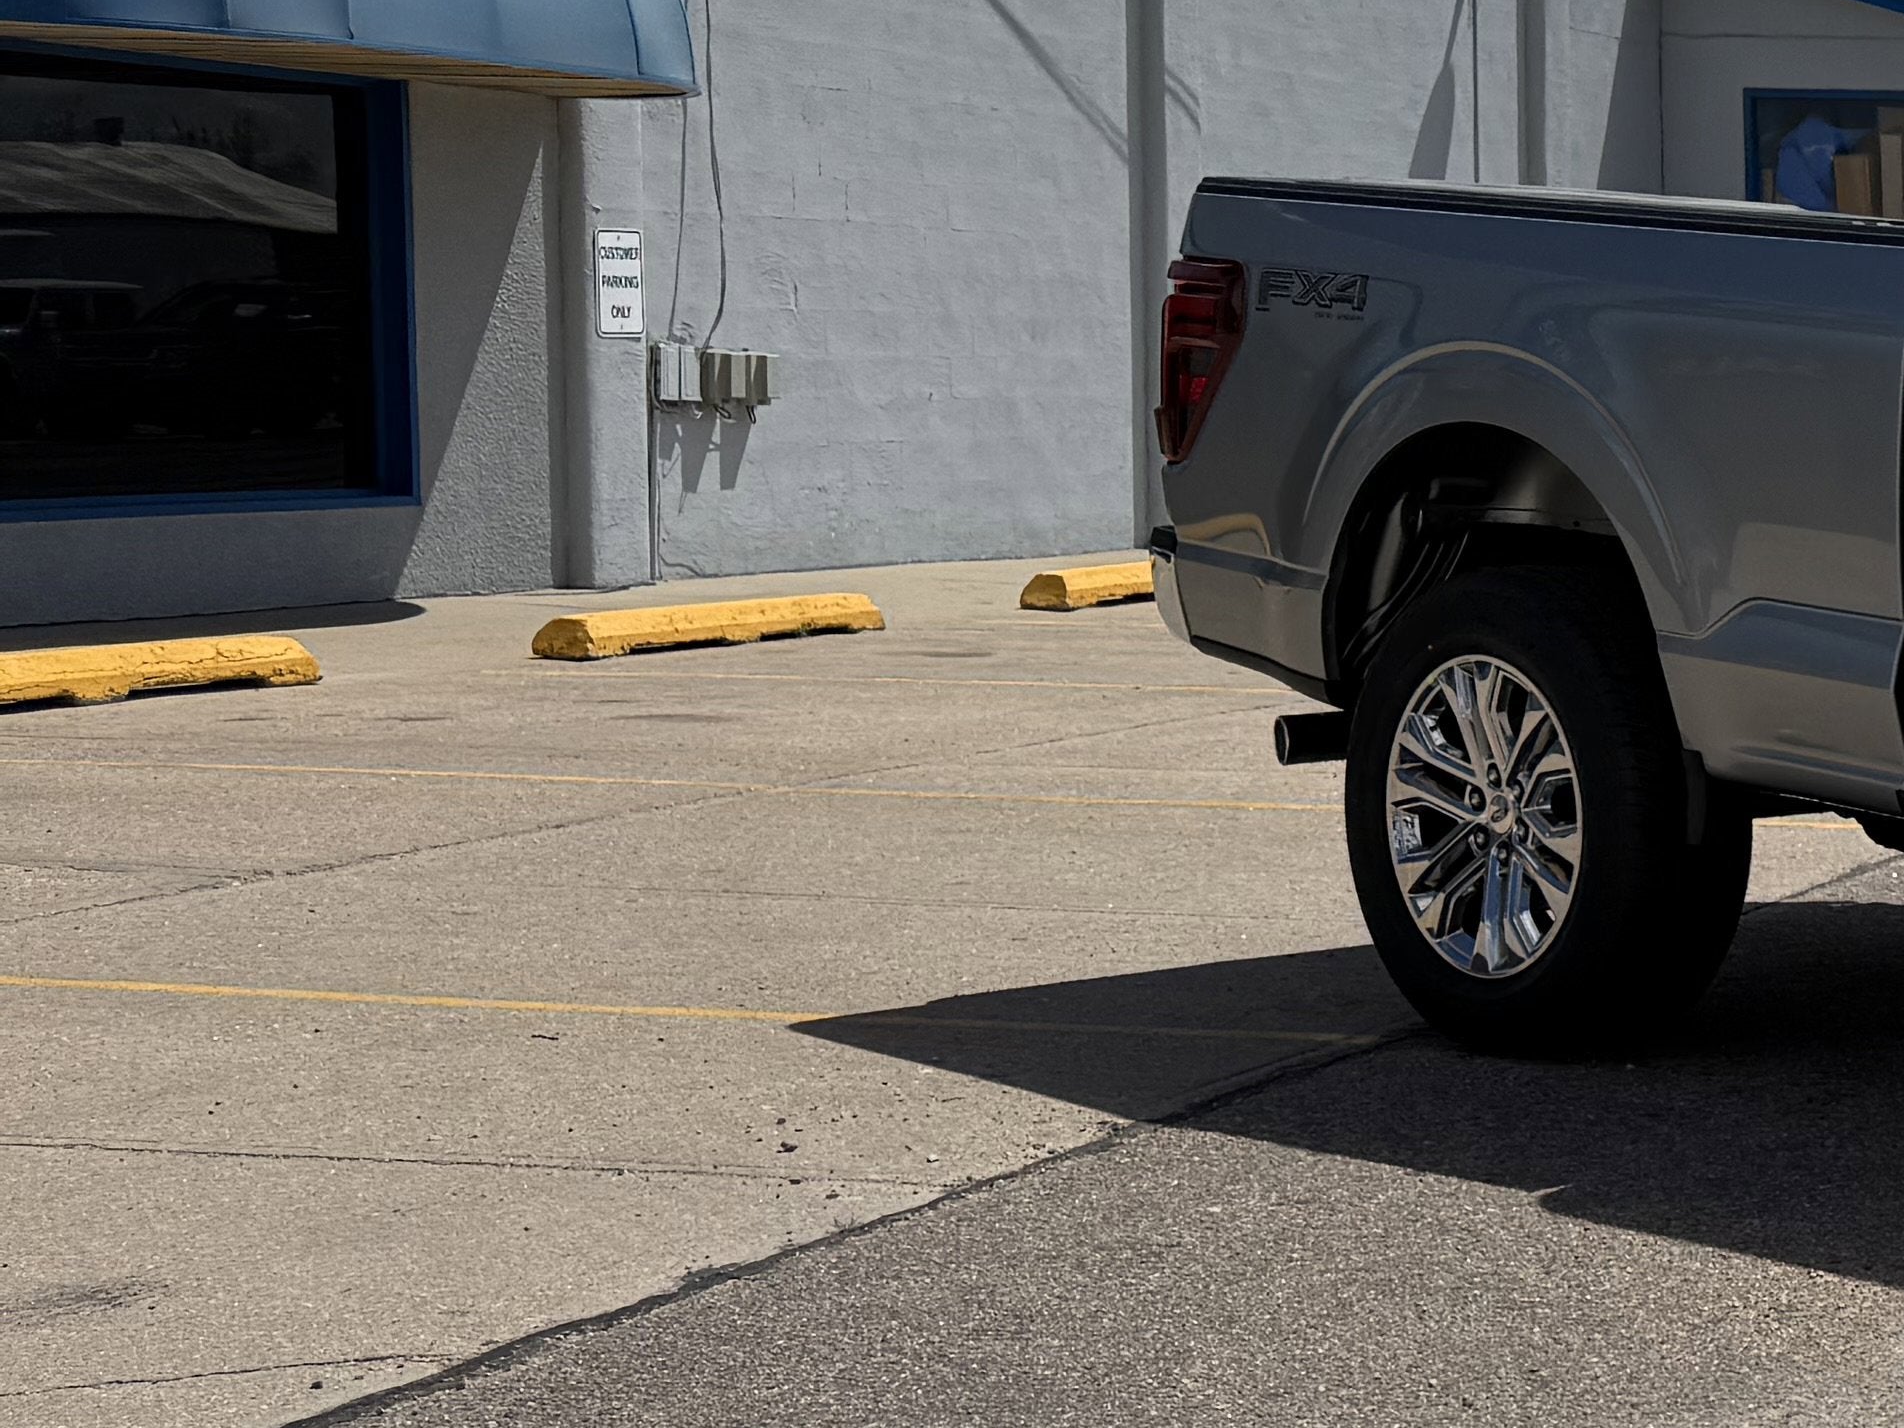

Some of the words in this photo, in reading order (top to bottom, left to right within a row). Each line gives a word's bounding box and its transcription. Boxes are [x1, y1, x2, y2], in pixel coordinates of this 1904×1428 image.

[602, 275, 639, 289] PARKING
[1255, 268, 1369, 312] FX4
[611, 305, 631, 318] ONLY
